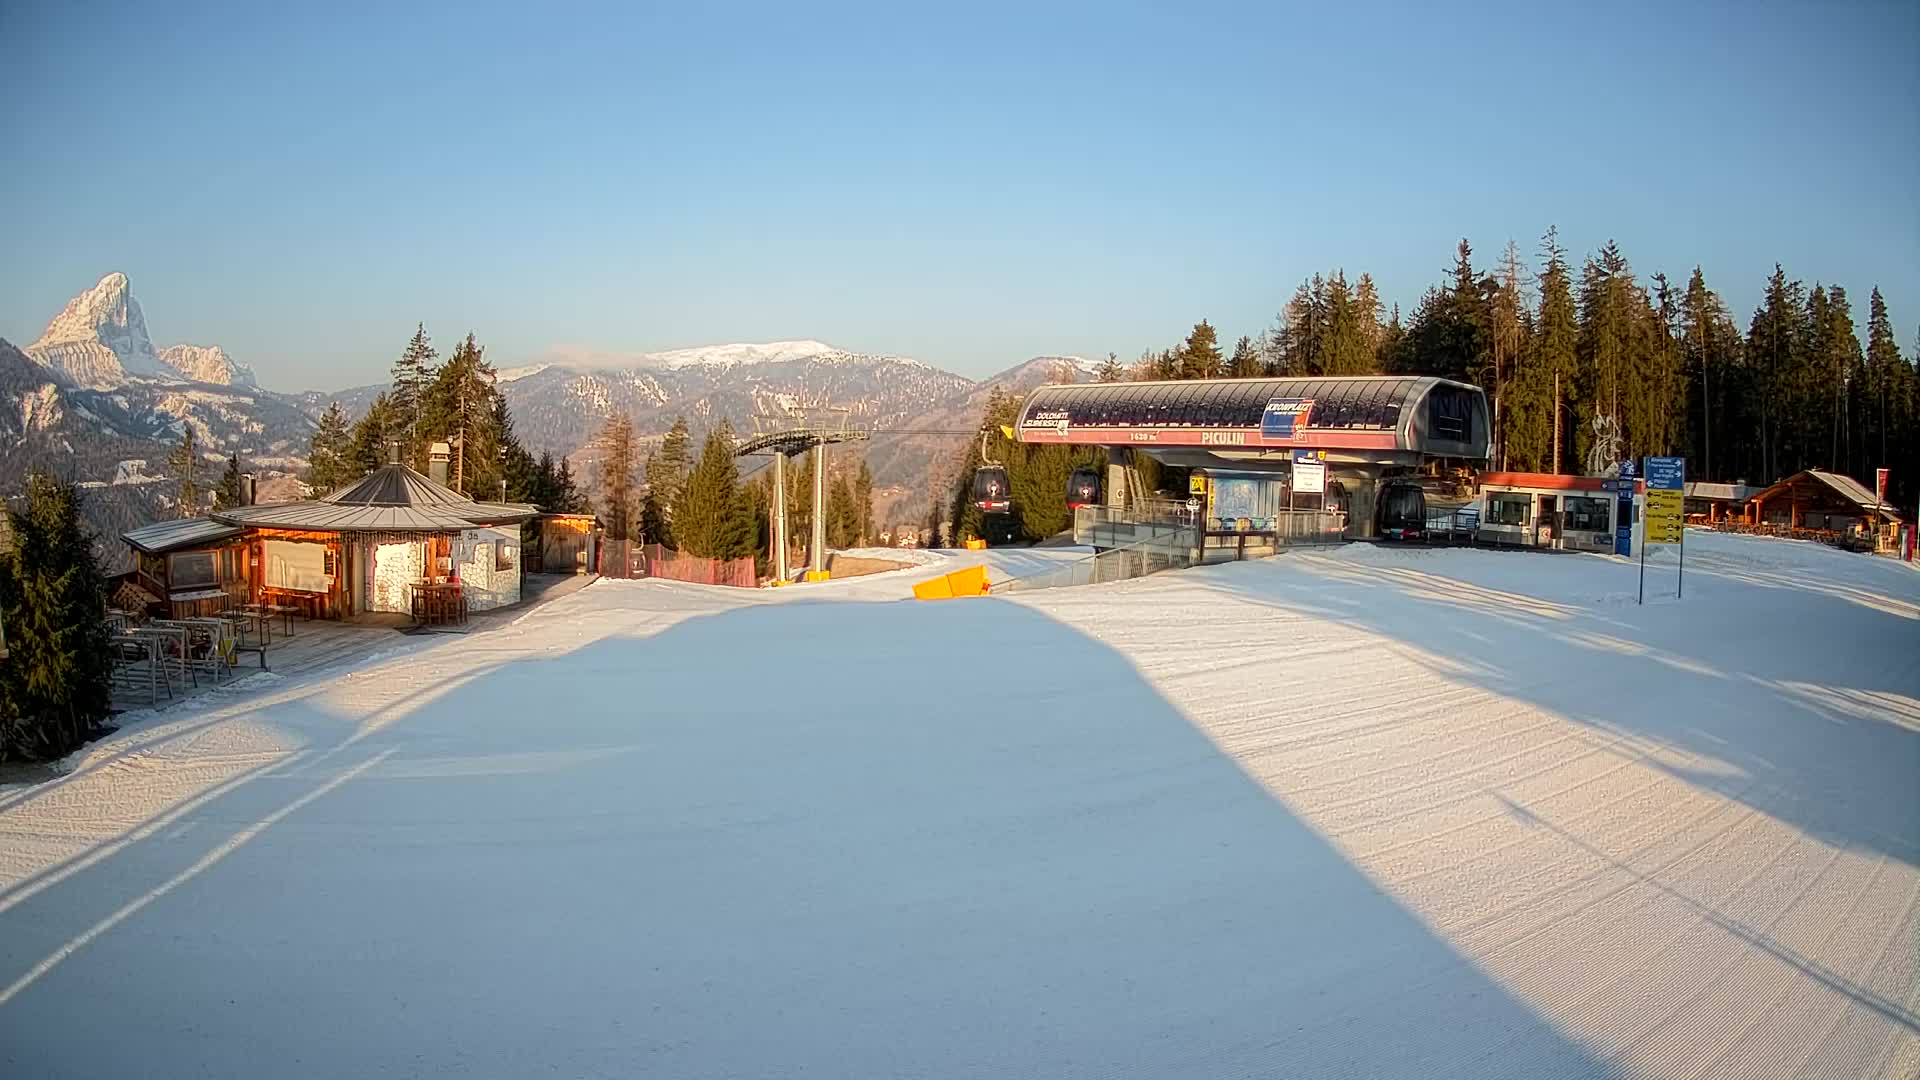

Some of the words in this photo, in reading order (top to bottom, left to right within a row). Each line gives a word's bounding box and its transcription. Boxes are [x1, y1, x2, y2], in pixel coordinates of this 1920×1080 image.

[1266, 403, 1312, 411] KRONPLATZ
[1035, 412, 1069, 420] DOLOMITI
[1201, 432, 1246, 446] PICULIN
